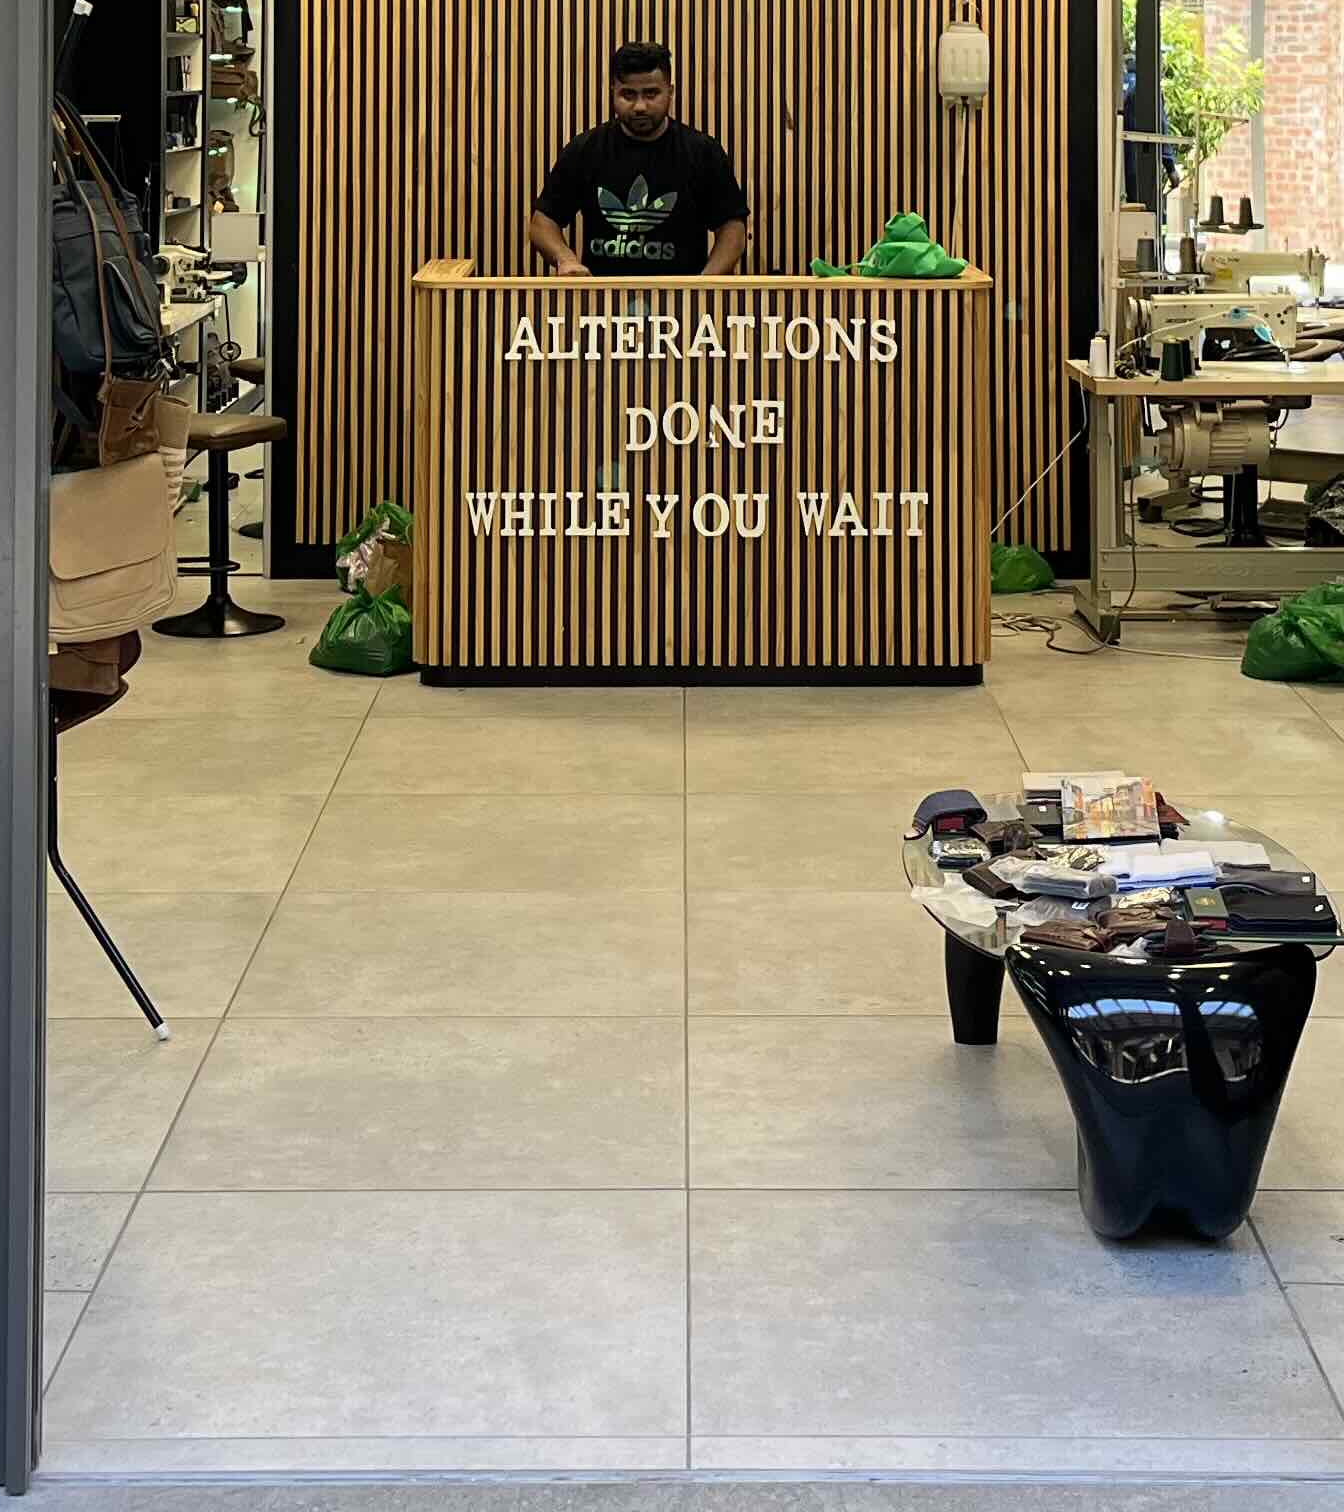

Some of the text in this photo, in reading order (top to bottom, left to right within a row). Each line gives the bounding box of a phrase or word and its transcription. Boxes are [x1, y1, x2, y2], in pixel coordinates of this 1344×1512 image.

[590, 235, 675, 260] adidas
[504, 313, 899, 363] ALTERATIONS
[625, 399, 785, 452] DONE
[466, 491, 929, 538] WHILE YOU WAIT
